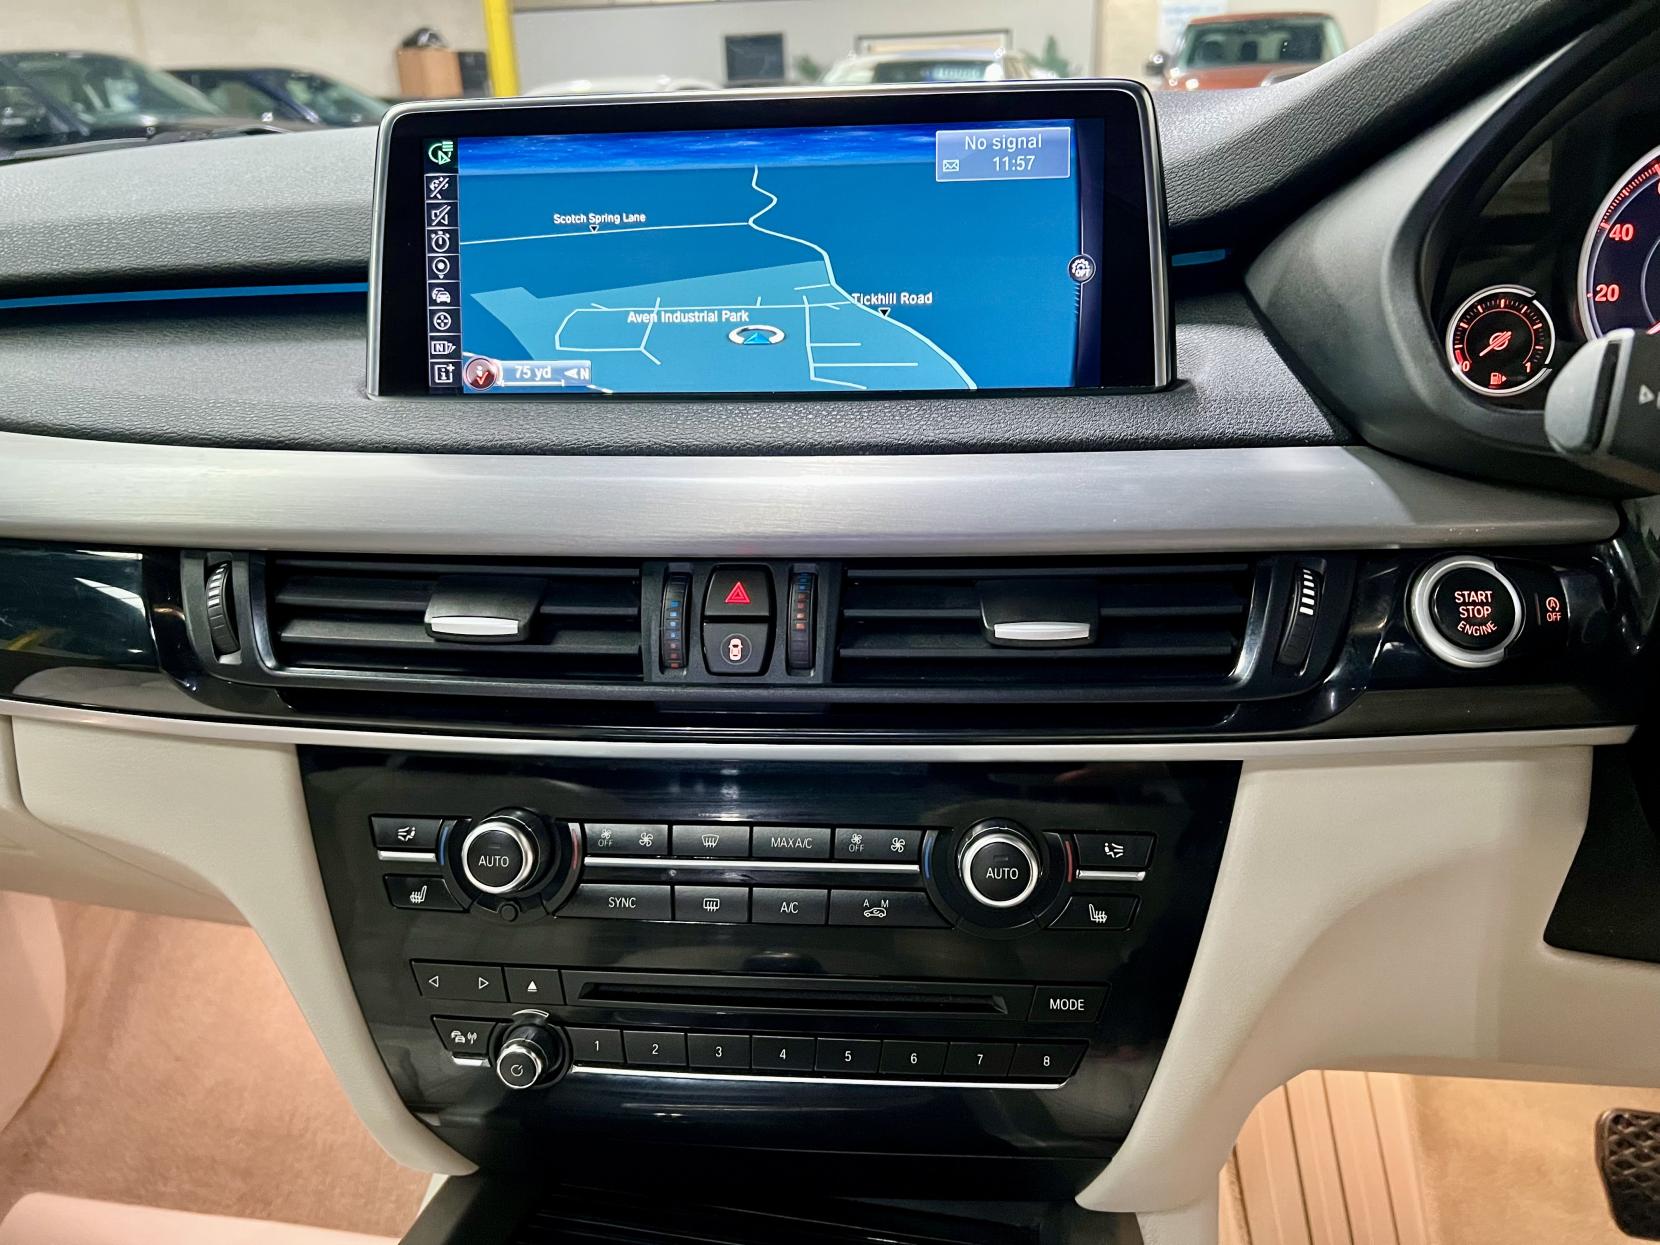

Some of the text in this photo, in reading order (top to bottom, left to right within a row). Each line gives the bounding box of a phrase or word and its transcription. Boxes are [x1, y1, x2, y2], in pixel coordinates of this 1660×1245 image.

[964, 133, 1042, 152] No signal
[992, 155, 1036, 171] 11:57
[553, 212, 647, 225] Scotch Spring Lane
[1608, 223, 1635, 242] 40
[851, 291, 933, 306] Tickhill Road
[1594, 284, 1620, 302] 20
[626, 309, 750, 323] Aven Industrial Park
[514, 365, 552, 381] 75 yd
[580, 367, 590, 380] N
[1461, 361, 1471, 373] 0
[1524, 361, 1532, 374] 1
[1454, 590, 1493, 604] START
[1458, 606, 1492, 618] STOP
[1546, 612, 1562, 622] OFF
[1457, 620, 1497, 636] ENGINE
[597, 838, 614, 847] OFF
[770, 837, 813, 849] MAX A/C
[848, 843, 864, 853] OFF
[477, 854, 510, 868] AUTO
[985, 867, 1019, 881] AUTO
[608, 896, 637, 909] SYNC
[780, 901, 799, 914] A/C
[863, 898, 870, 908] A
[880, 899, 889, 908] M
[1049, 998, 1085, 1011] MODE
[594, 1040, 599, 1051] 1
[651, 1043, 659, 1055] 2
[715, 1046, 722, 1058] 3
[779, 1048, 787, 1060] 4
[844, 1050, 852, 1062] 5
[910, 1053, 918, 1065] 6
[976, 1054, 984, 1065] 7
[1043, 1055, 1051, 1067] 8
